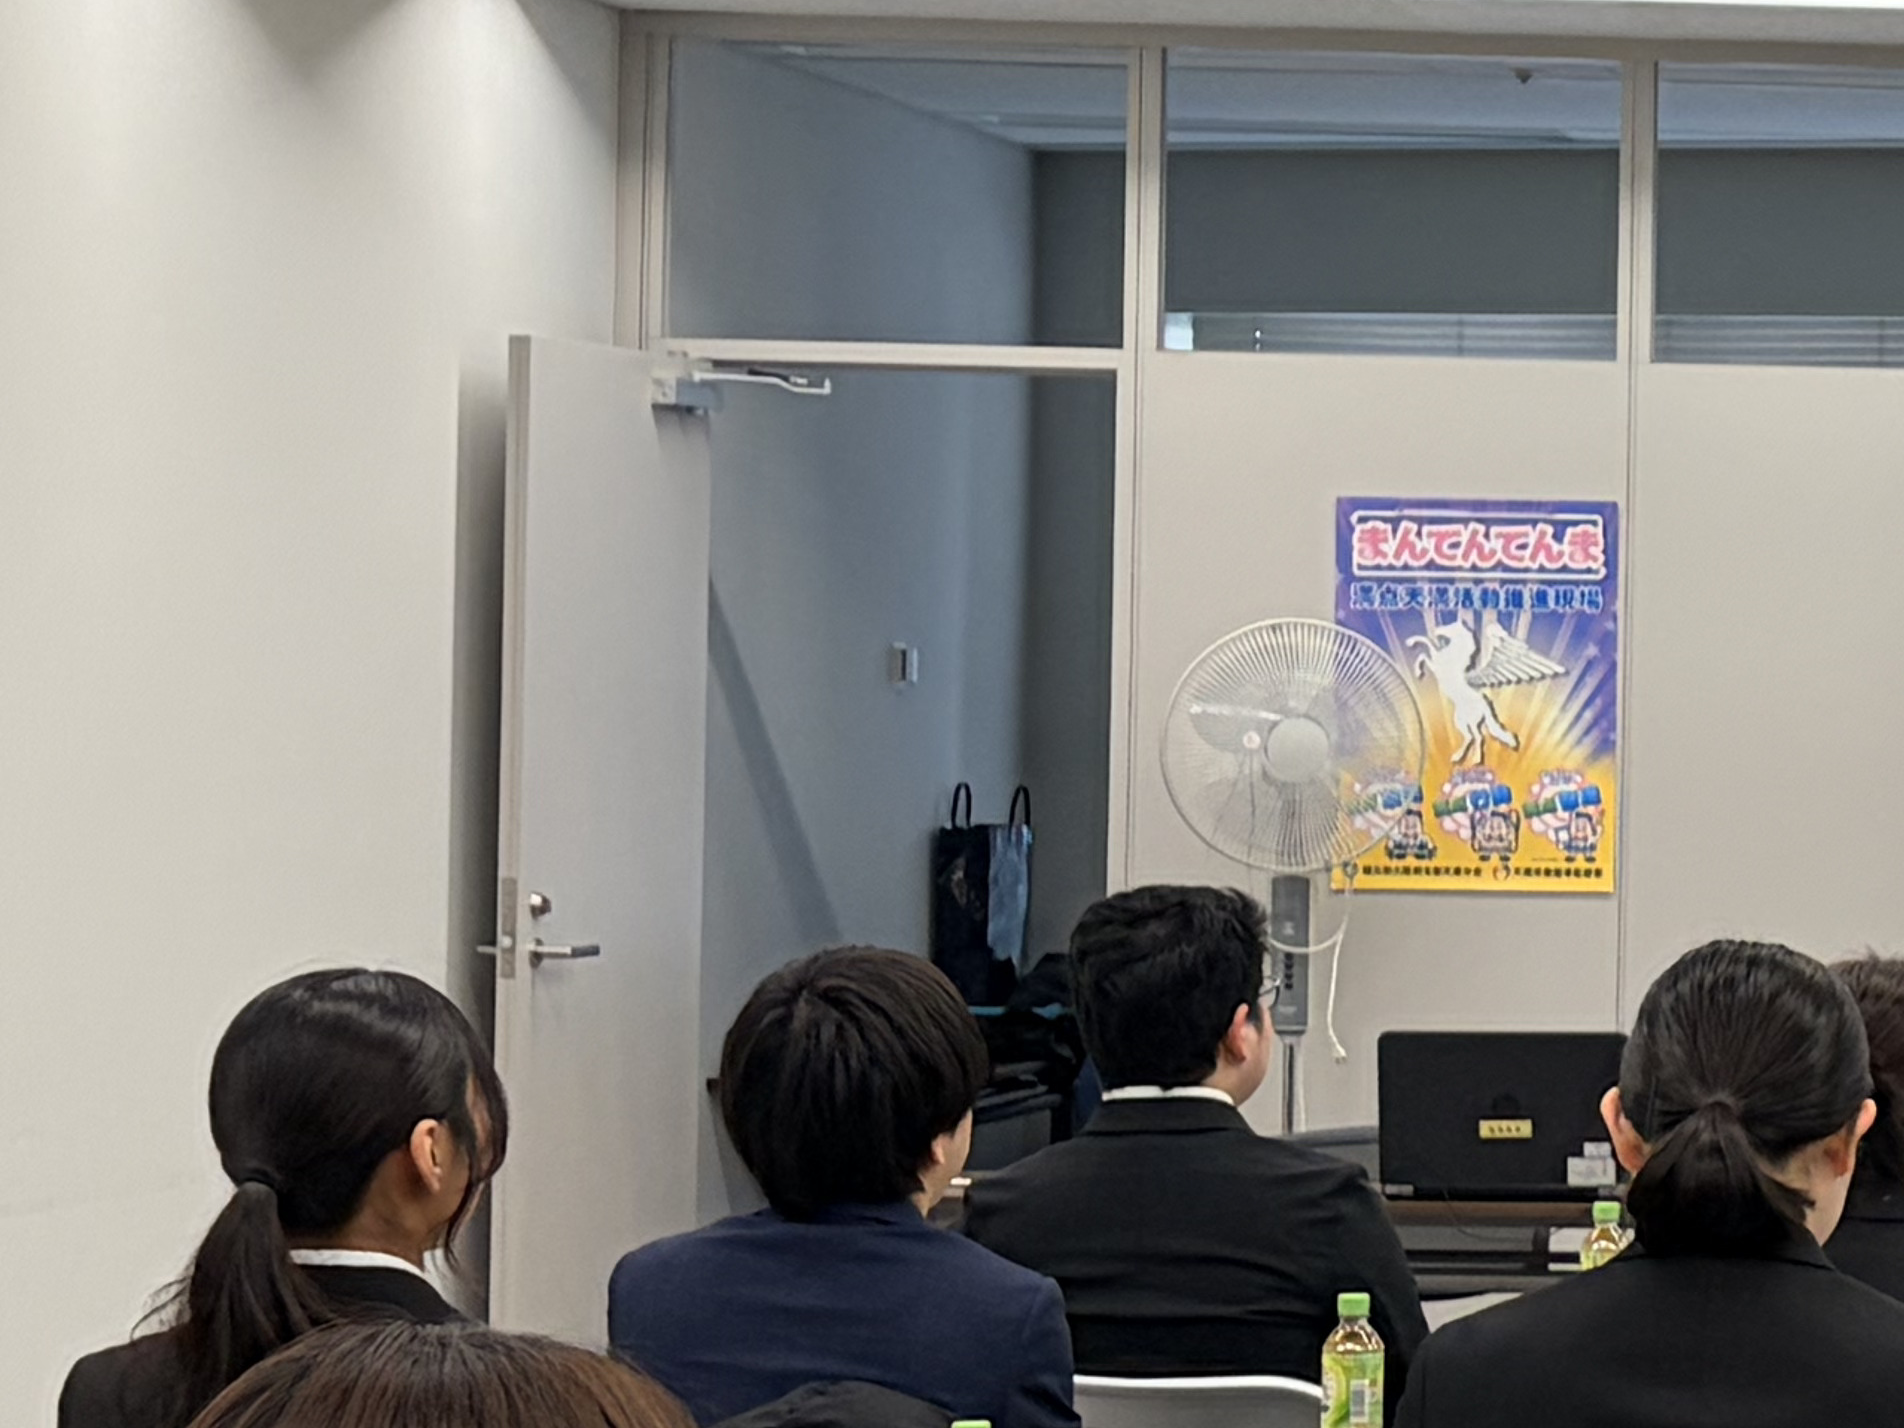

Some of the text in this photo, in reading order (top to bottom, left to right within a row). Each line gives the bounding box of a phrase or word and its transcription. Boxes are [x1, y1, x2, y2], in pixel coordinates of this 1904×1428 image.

[1354, 522, 1603, 567] まんてんてんま
